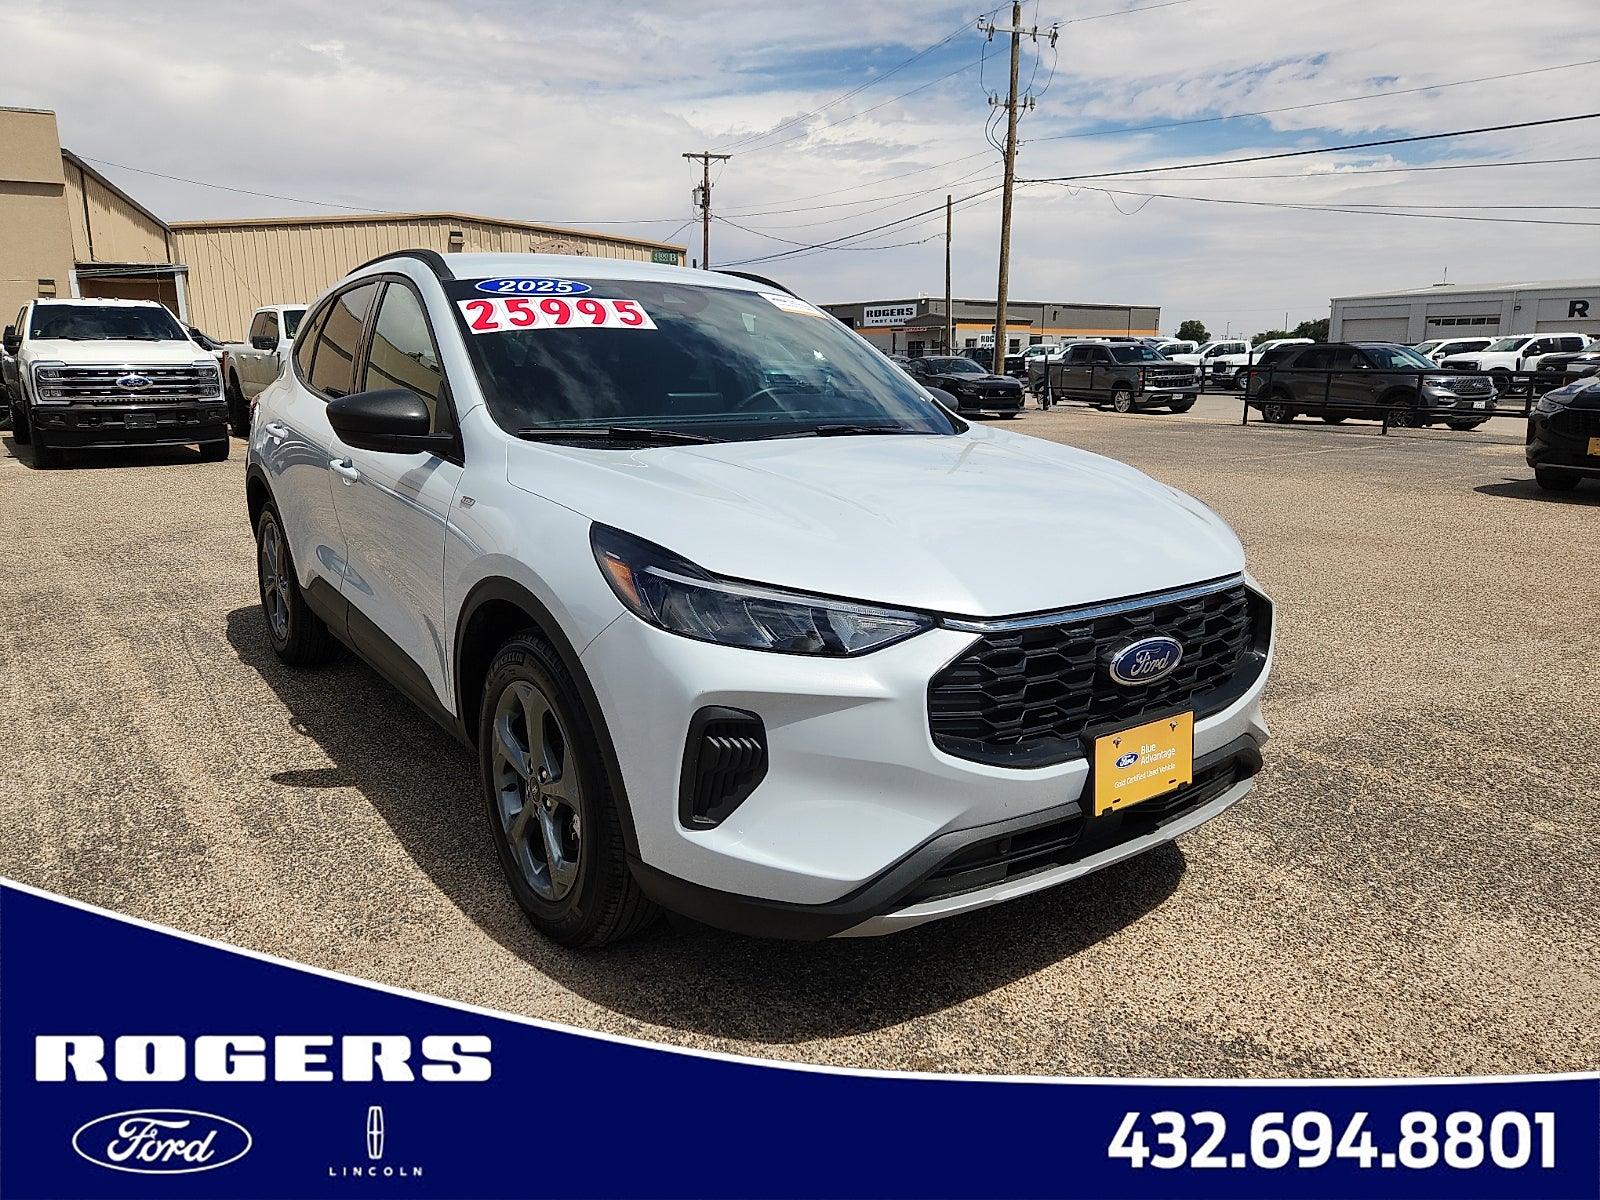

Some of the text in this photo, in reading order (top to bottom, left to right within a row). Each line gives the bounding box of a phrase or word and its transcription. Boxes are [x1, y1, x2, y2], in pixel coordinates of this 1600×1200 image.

[497, 280, 574, 293] 2025
[466, 298, 644, 331] 25995
[866, 308, 914, 318] ROGERS
[493, 652, 524, 673] MICHELIN
[1130, 646, 1171, 677] Ford
[1140, 743, 1156, 755] Blue
[1140, 747, 1176, 766] Advantage
[1114, 762, 1176, 789] Gold Certified Used Vehicle
